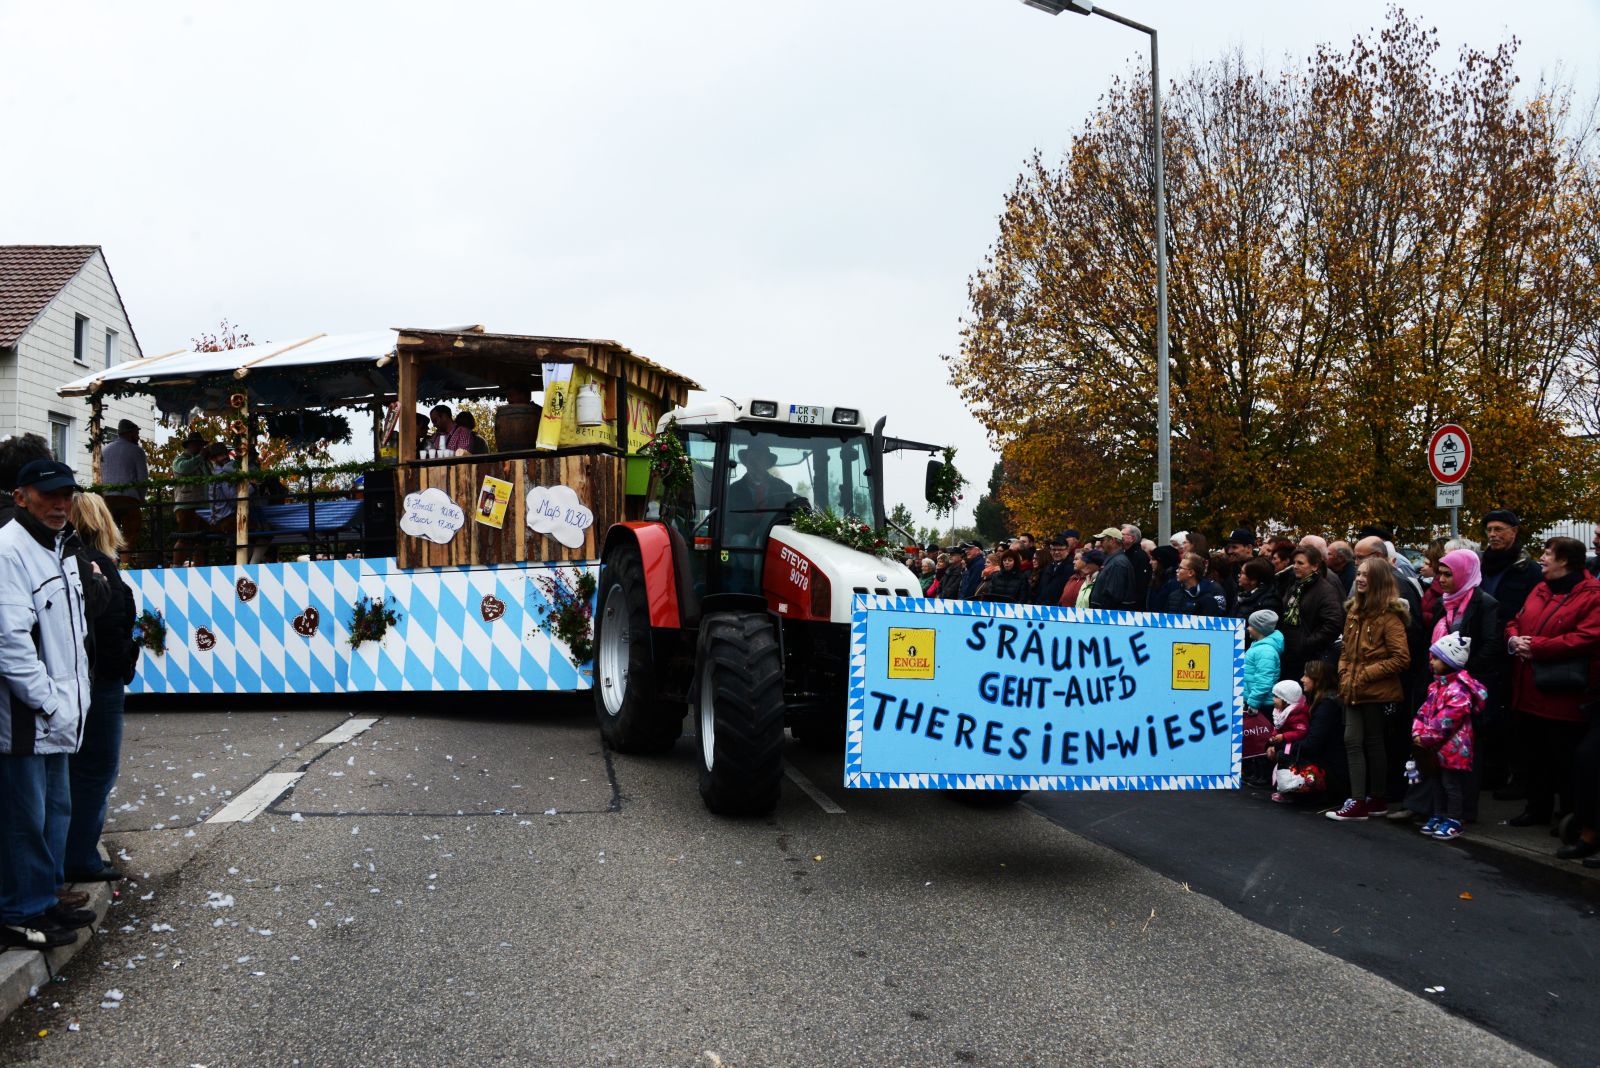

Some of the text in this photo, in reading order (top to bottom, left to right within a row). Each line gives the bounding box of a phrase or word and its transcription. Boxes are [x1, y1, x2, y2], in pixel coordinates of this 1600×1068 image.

[799, 406, 809, 415] CR
[1439, 489, 1460, 497] Anlieger
[780, 546, 809, 573] STEYR
[789, 568, 809, 591] 9078
[893, 657, 931, 668] ENGEL
[1176, 669, 1206, 680] ENGEL
[1241, 725, 1270, 737] ONITA
